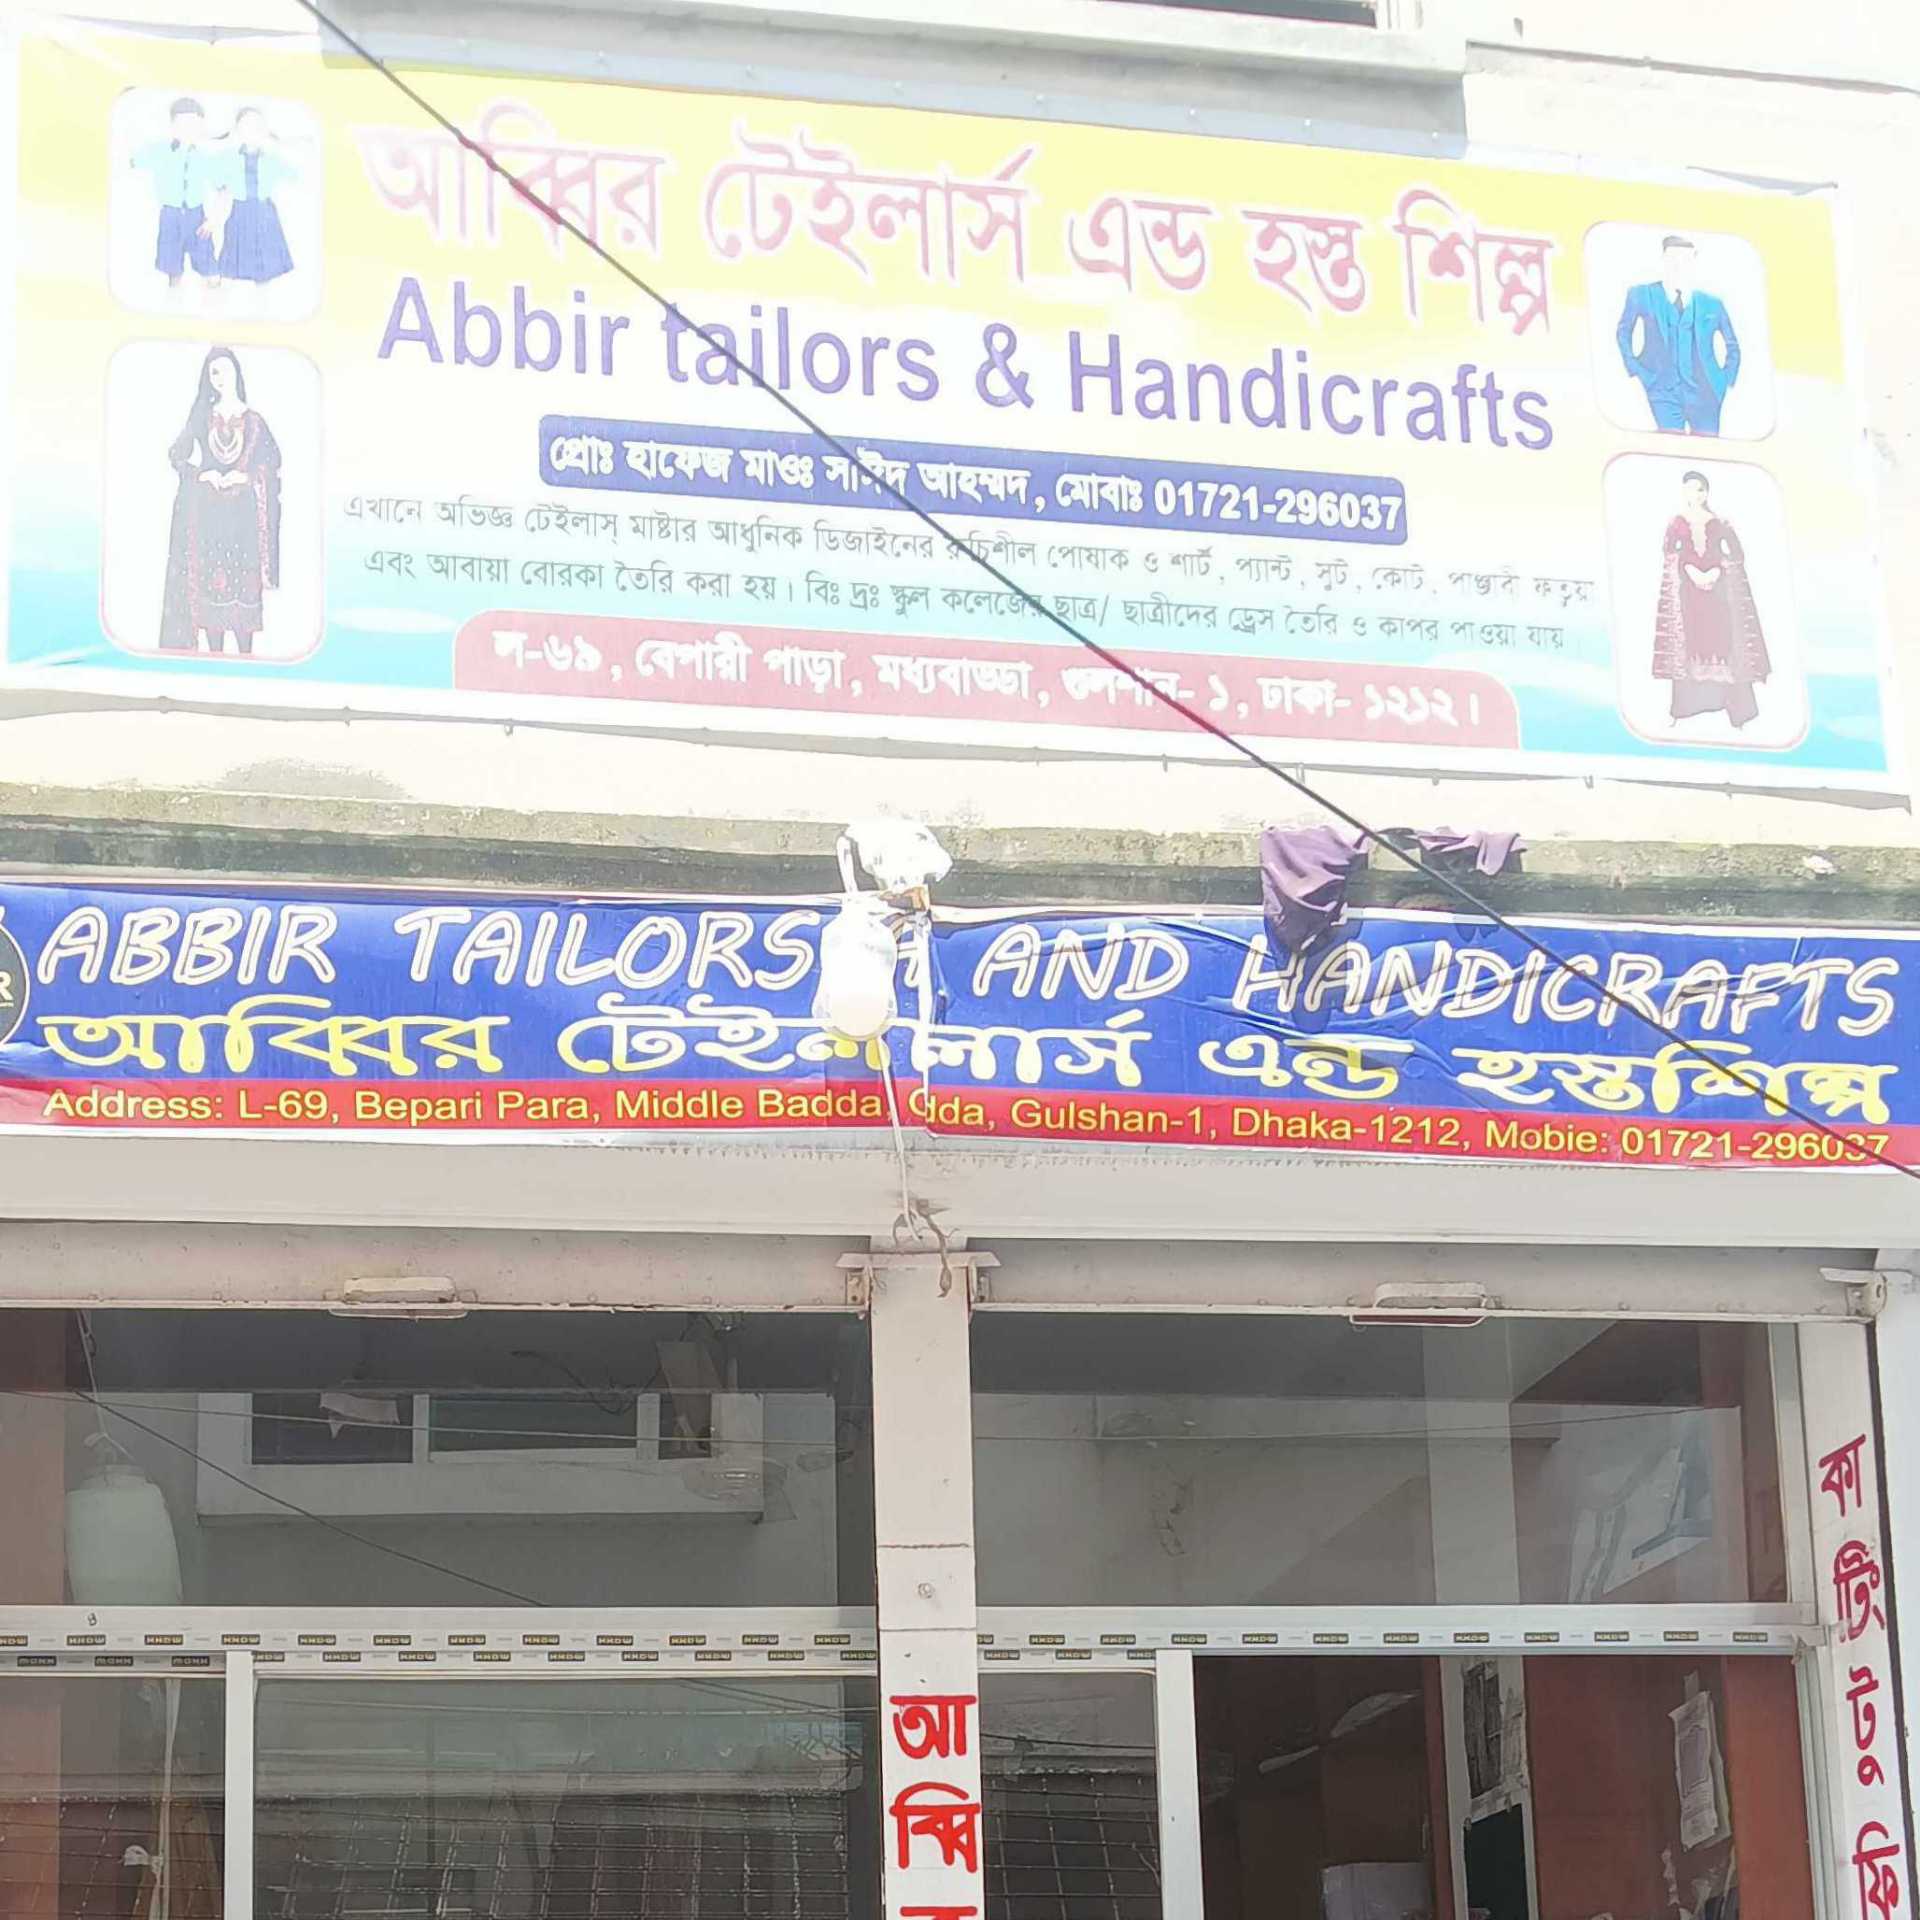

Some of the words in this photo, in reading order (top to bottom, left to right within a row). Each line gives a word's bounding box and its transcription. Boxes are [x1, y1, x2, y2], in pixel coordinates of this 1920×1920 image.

[705, 120, 1033, 282] টেইলার্স
[1068, 197, 1212, 291] এন্ড
[1242, 209, 1365, 312] হস্ত
[1392, 189, 1553, 335] শিল্প
[378, 277, 629, 375] Abbir
[661, 301, 940, 401] tailors
[975, 323, 1034, 409] &
[1069, 331, 1553, 450] Handicrafts
[623, 440, 734, 483] হাফেজ
[1154, 479, 1402, 531] 01721-296037
[345, 496, 422, 523] এখানে
[708, 515, 802, 553] আধুনিক
[815, 519, 933, 558] ডিজাইনের
[365, 550, 416, 578] এবং
[684, 571, 732, 598] করা
[38, 904, 337, 986] ABBIR
[393, 906, 821, 991] TAILORS
[972, 922, 1190, 1001] AND
[1232, 933, 1900, 1038] HANDICRAFTS
[1199, 1032, 1415, 1101] এন্ড
[42, 1088, 224, 1120] Address:
[239, 1090, 339, 1124] L-69,
[354, 1089, 482, 1127] Bepari
[497, 1090, 601, 1124] Para,
[615, 1088, 745, 1120] Middle
[1010, 1098, 1217, 1140] Gulshan-1,
[1232, 1107, 1471, 1151] Dhaka-1212,
[1485, 1118, 1608, 1154] Mobie:
[1621, 1126, 1890, 1162] 01721-296037
